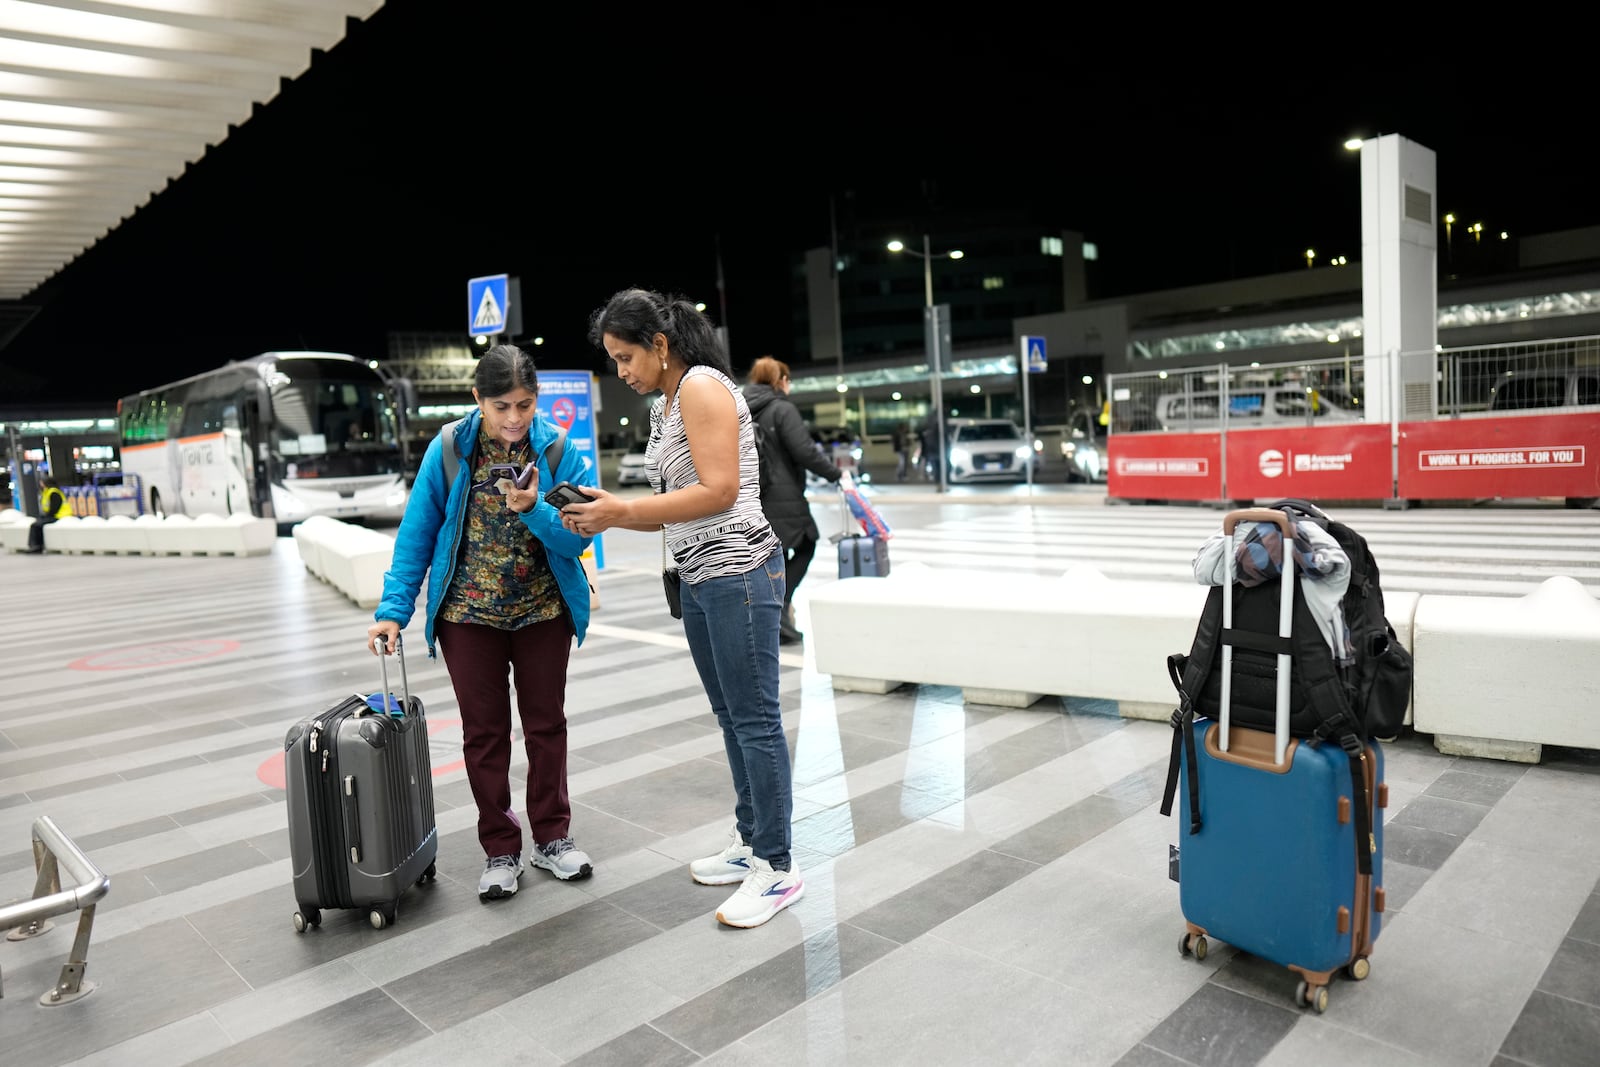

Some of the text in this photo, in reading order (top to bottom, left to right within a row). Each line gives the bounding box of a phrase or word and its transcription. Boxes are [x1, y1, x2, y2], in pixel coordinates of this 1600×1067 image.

[1428, 450, 1574, 466] WORK IN PROGRESS. FOR YOU
